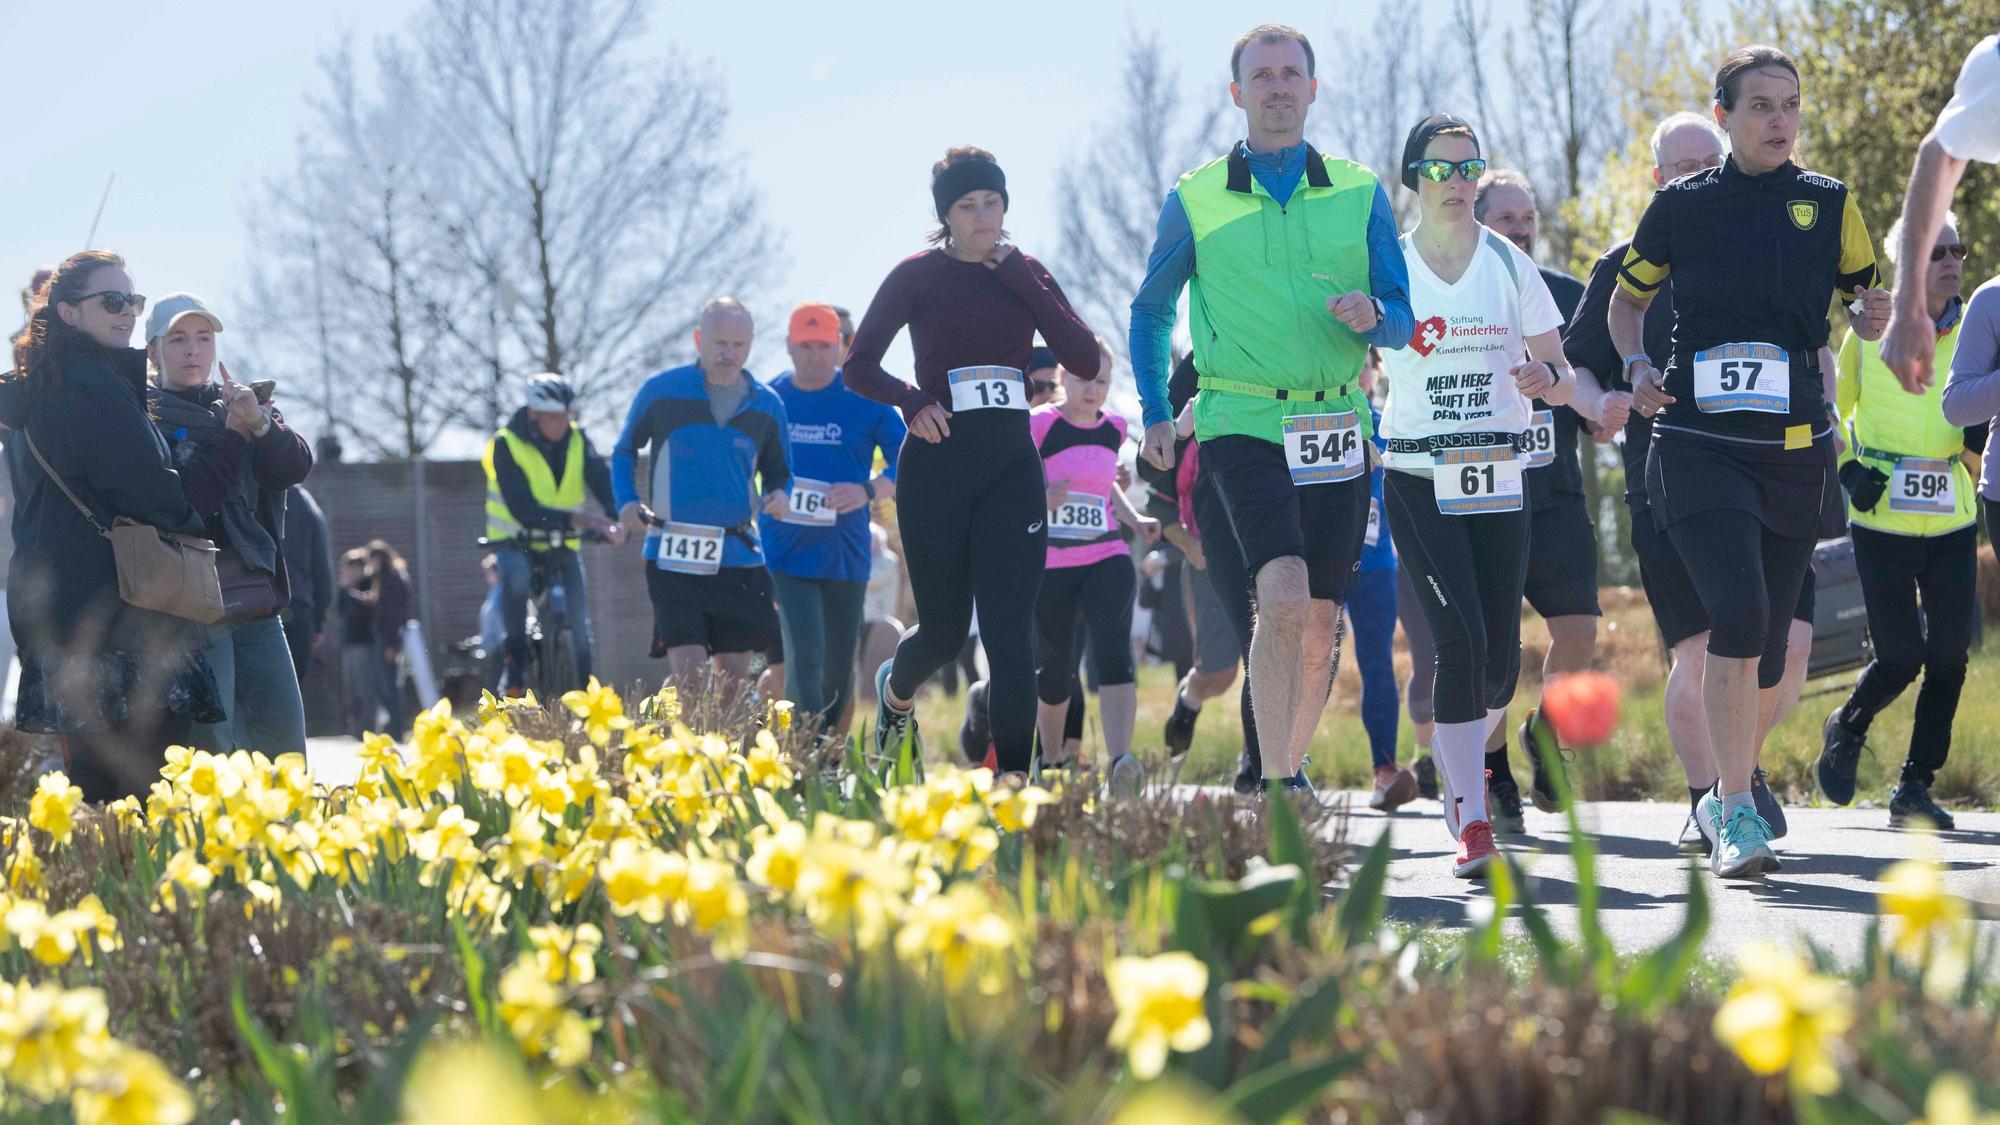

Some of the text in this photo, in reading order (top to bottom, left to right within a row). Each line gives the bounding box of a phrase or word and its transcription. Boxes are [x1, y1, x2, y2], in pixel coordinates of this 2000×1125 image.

[1676, 176, 1719, 191] FUSION
[1796, 174, 1840, 190] FUSION
[1794, 207, 1812, 217] TuS
[1450, 316, 1484, 325] Stiftung
[1451, 324, 1509, 337] KinderHerz
[1426, 372, 1494, 391] MEIN HERZ
[1720, 361, 1763, 392] 57
[975, 381, 1010, 406] 13
[1467, 387, 1490, 407] FÜR
[1299, 429, 1357, 465] 546
[1428, 433, 1496, 448] SUNDRIED
[1460, 464, 1495, 496] 61
[1903, 473, 1948, 498] 598
[1052, 504, 1103, 527] 1388
[665, 536, 718, 561] 1412
